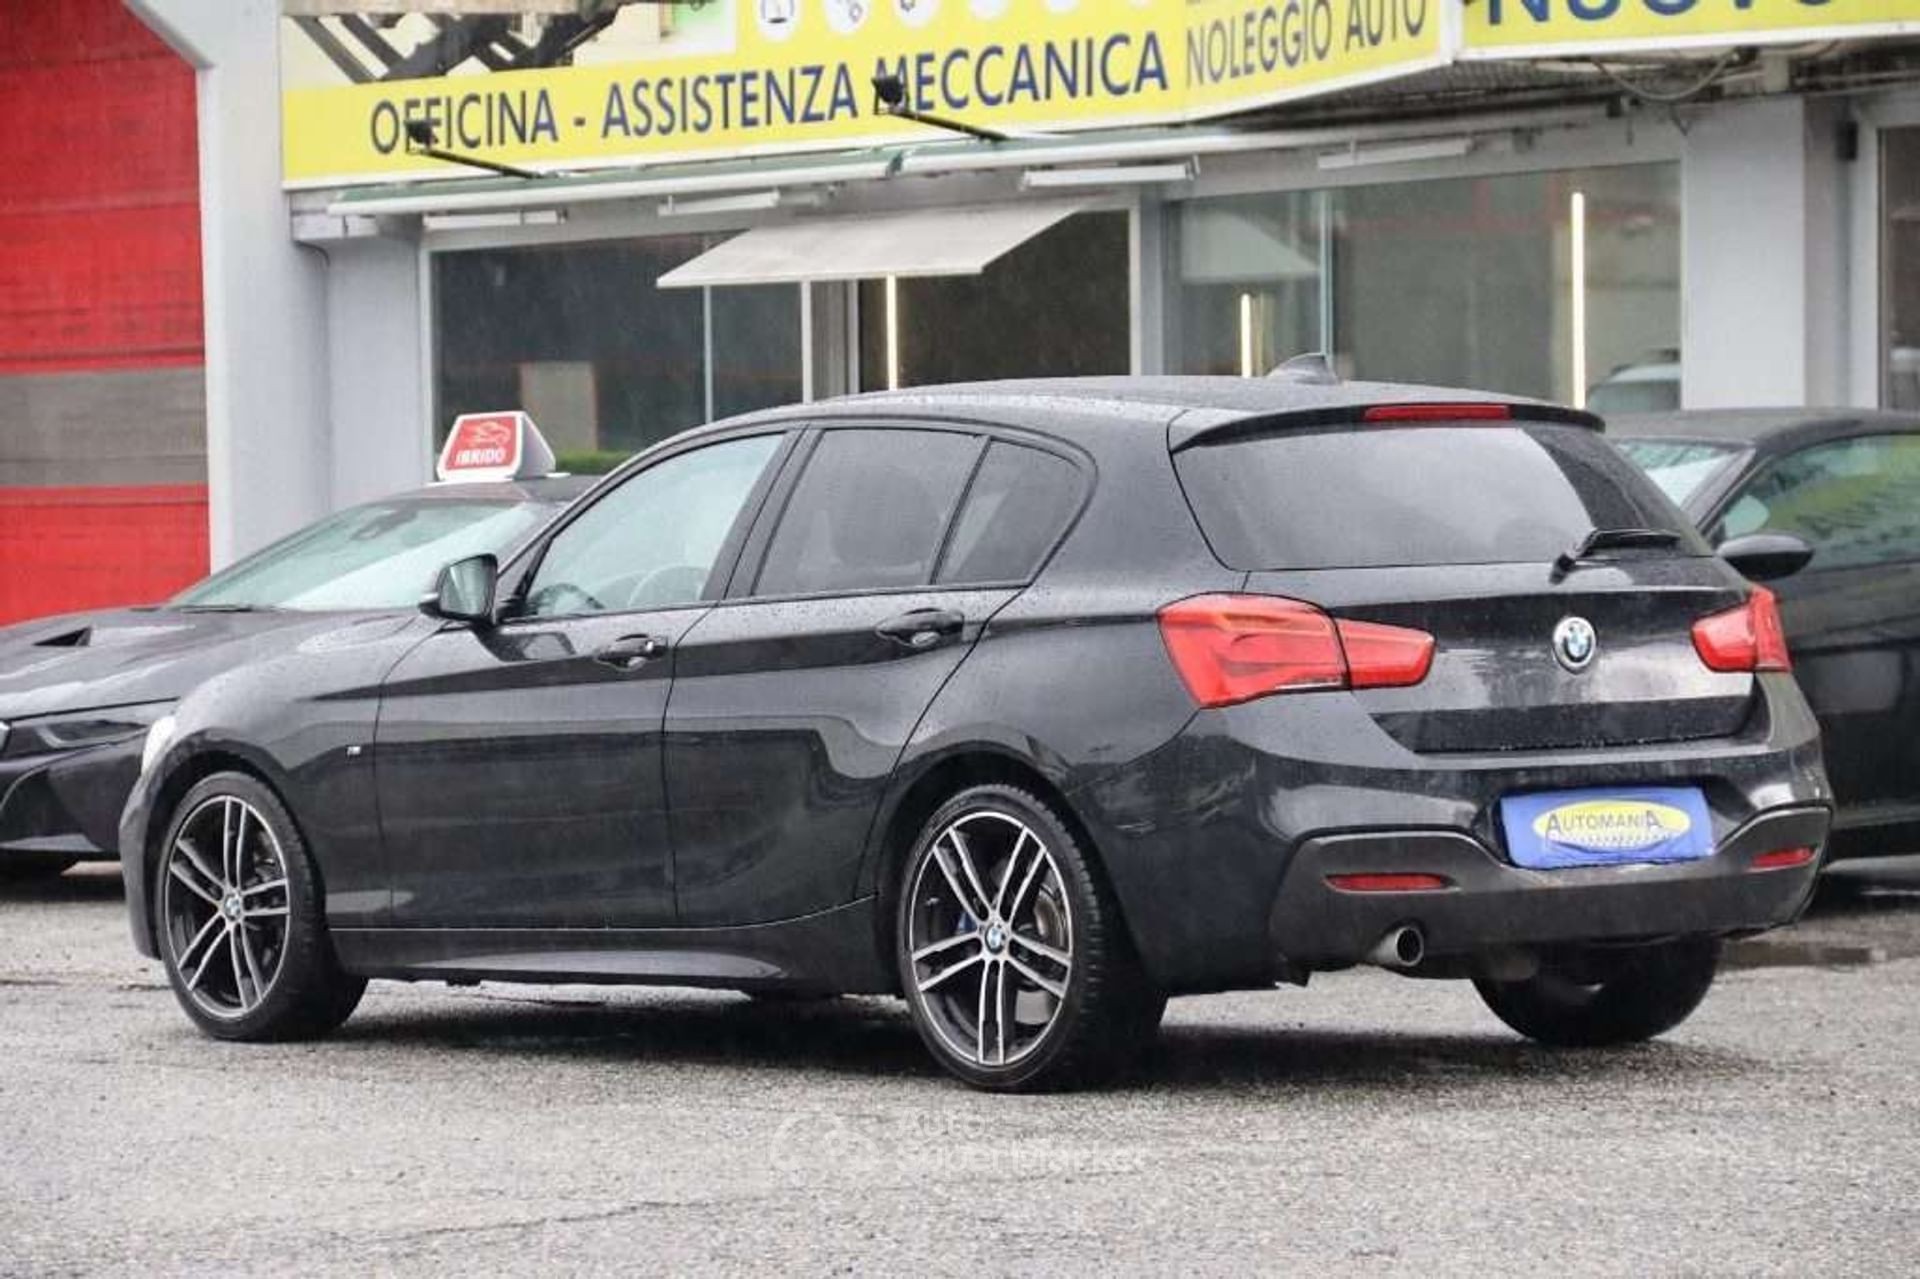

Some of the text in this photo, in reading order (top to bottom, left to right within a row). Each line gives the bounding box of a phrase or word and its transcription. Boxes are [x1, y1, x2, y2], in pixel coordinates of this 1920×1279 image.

[371, 88, 558, 154] OFFICINA
[602, 62, 858, 138] ASSISTENZA
[874, 31, 1169, 112] MECCANICA
[1186, 0, 1333, 86] NOLEGGIO
